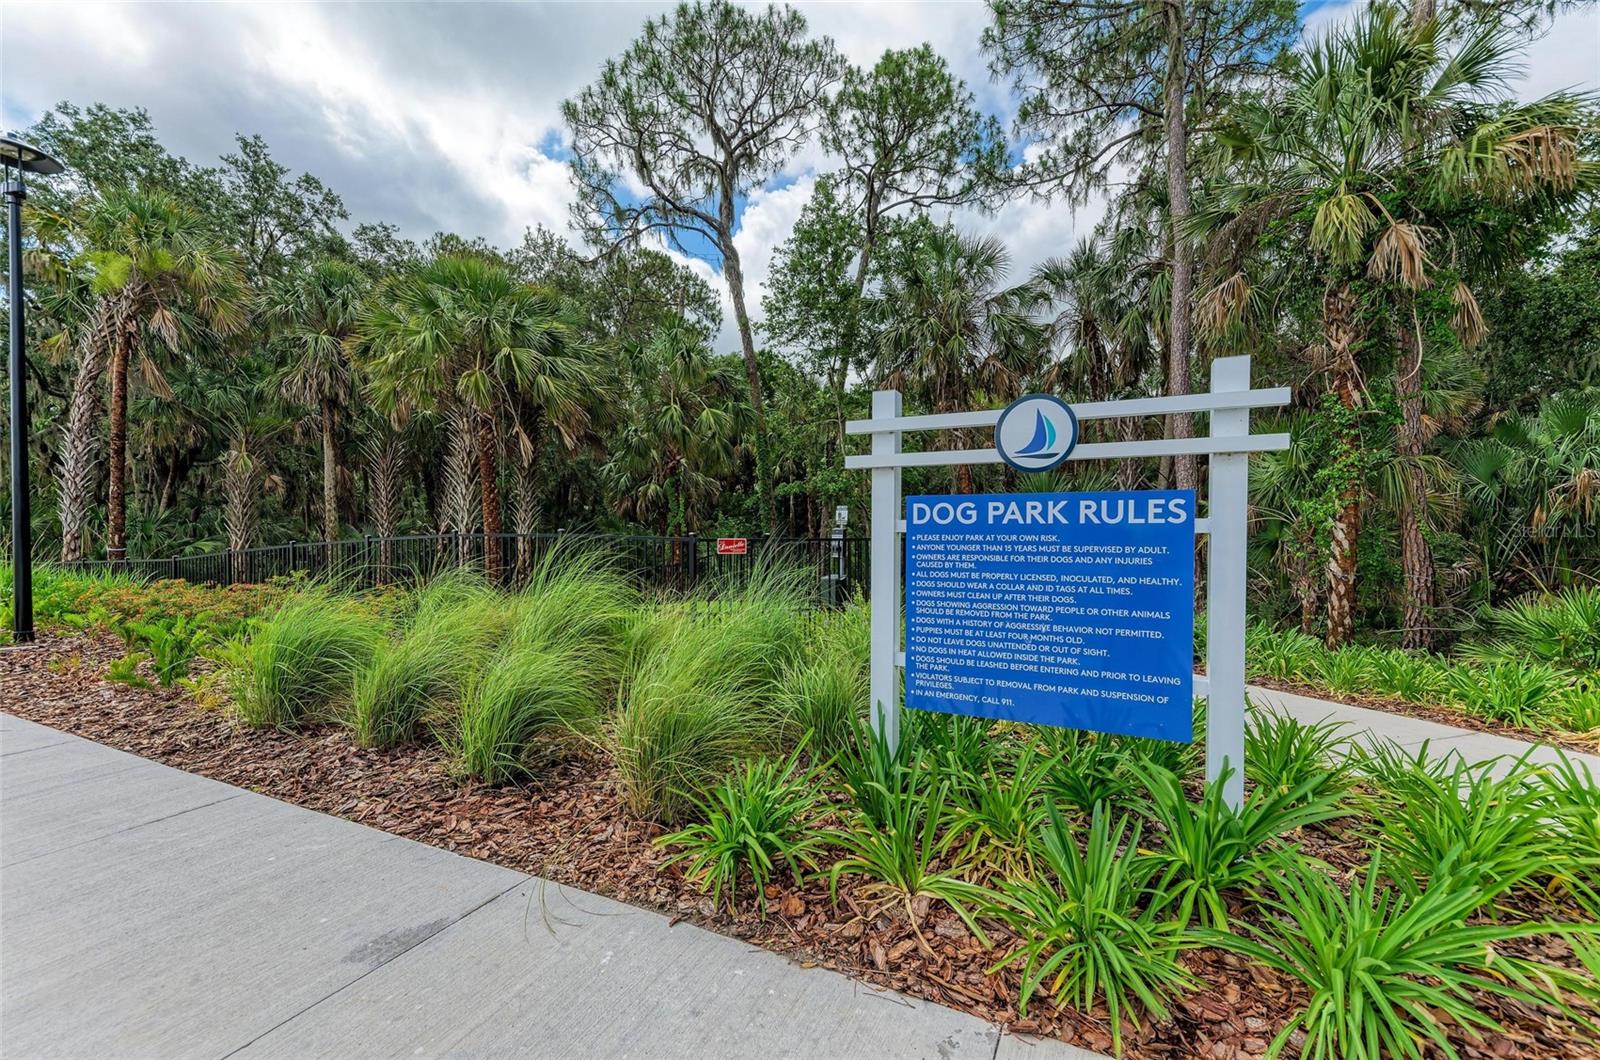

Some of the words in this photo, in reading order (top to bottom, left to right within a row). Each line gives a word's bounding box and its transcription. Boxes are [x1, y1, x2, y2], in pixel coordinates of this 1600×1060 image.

[912, 502, 977, 525] DOG
[988, 500, 1069, 524] PARK
[1079, 498, 1187, 524] RULES
[996, 534, 1017, 542] YOUR
[1040, 534, 1060, 542] RISK.
[1062, 545, 1071, 553] BE
[1073, 545, 1123, 553] SUPERVISED
[1138, 546, 1169, 554] ADULT.
[916, 553, 946, 561] OWNERS
[961, 554, 1008, 562] RESPONSIBLE
[1027, 555, 1049, 563] THEIR
[1074, 556, 1094, 564] AND
[1115, 557, 1153, 565] INJURIES
[981, 572, 1018, 580] PROPERLY
[1020, 574, 1058, 582] LICENSED,
[1061, 575, 1115, 584] INOCULATED,
[1139, 577, 1182, 585] HEALTHY.
[995, 583, 1025, 591] COLLAR
[1026, 584, 1044, 592] AND
[1055, 585, 1076, 593] TAGS
[1106, 587, 1132, 595] TIMES.
[915, 590, 946, 598] OWNERS
[1004, 593, 1026, 601] AFTER
[1028, 594, 1050, 602] THEIR
[1051, 595, 1076, 603] DOGS.
[916, 599, 935, 607] DOGS
[936, 600, 971, 608] SHOWING
[971, 602, 1019, 611] AGGRESSION
[1020, 604, 1054, 613] TOWARD
[1055, 606, 1085, 615] PEOPLE
[1100, 608, 1129, 617] OTHER
[1131, 610, 1170, 619] ANIMALS
[916, 607, 944, 615] SHOULD
[945, 608, 954, 616] BE
[955, 609, 990, 618] REMOVED
[1014, 612, 1028, 620] THE
[1030, 613, 1052, 621] PARK.
[916, 616, 935, 624] DOGS
[962, 619, 992, 627] HISTORY
[1005, 622, 1051, 632] AGGRESSIVE
[1052, 625, 1093, 634] BEHAVIOR
[1115, 628, 1164, 639] PERMITTED.
[916, 626, 943, 634] PUPPIES
[1008, 632, 1029, 640] FOUR
[1029, 634, 1064, 643] MONTHS
[1065, 636, 1085, 644] OLD.
[943, 638, 964, 646] LEAVE
[965, 639, 986, 647] DOGS
[987, 641, 1037, 651] UNATTENDED
[1083, 648, 1109, 656] SIGHT.
[915, 645, 927, 653] NO
[928, 646, 947, 654] DOGS
[977, 650, 1013, 659] ALLOWED
[1014, 653, 1038, 662] INSIDE
[1040, 655, 1055, 663] THE
[1057, 656, 1080, 665] PARK.
[915, 662, 928, 670] THE
[929, 663, 949, 671] PARK.
[915, 655, 935, 663] DOGS
[936, 657, 965, 666] SHOULD
[966, 659, 975, 667] BE
[976, 660, 1009, 669] LEASHED
[1010, 663, 1038, 672] BEFORE
[1040, 665, 1079, 676] ENTERING
[1081, 670, 1099, 678] AND
[1101, 671, 1127, 680] PRIOR
[1129, 673, 1141, 682] TO
[1142, 675, 1181, 685] LEAVING
[915, 679, 955, 690] PRIVILEGES.
[915, 672, 953, 682] VIOLATORS
[954, 675, 983, 685] SUBJECT
[985, 678, 995, 686] TO
[996, 680, 1032, 690] REMOVAL
[1033, 683, 1056, 692] FROM
[1057, 686, 1079, 695] PARK
[1080, 688, 1099, 697] AND
[1101, 690, 1154, 702] SUSPENSION
[1156, 696, 1168, 704] OF
[935, 691, 980, 703] EMERGENCY,
[981, 696, 1000, 705] CALL
[1001, 698, 1014, 706] 911.
